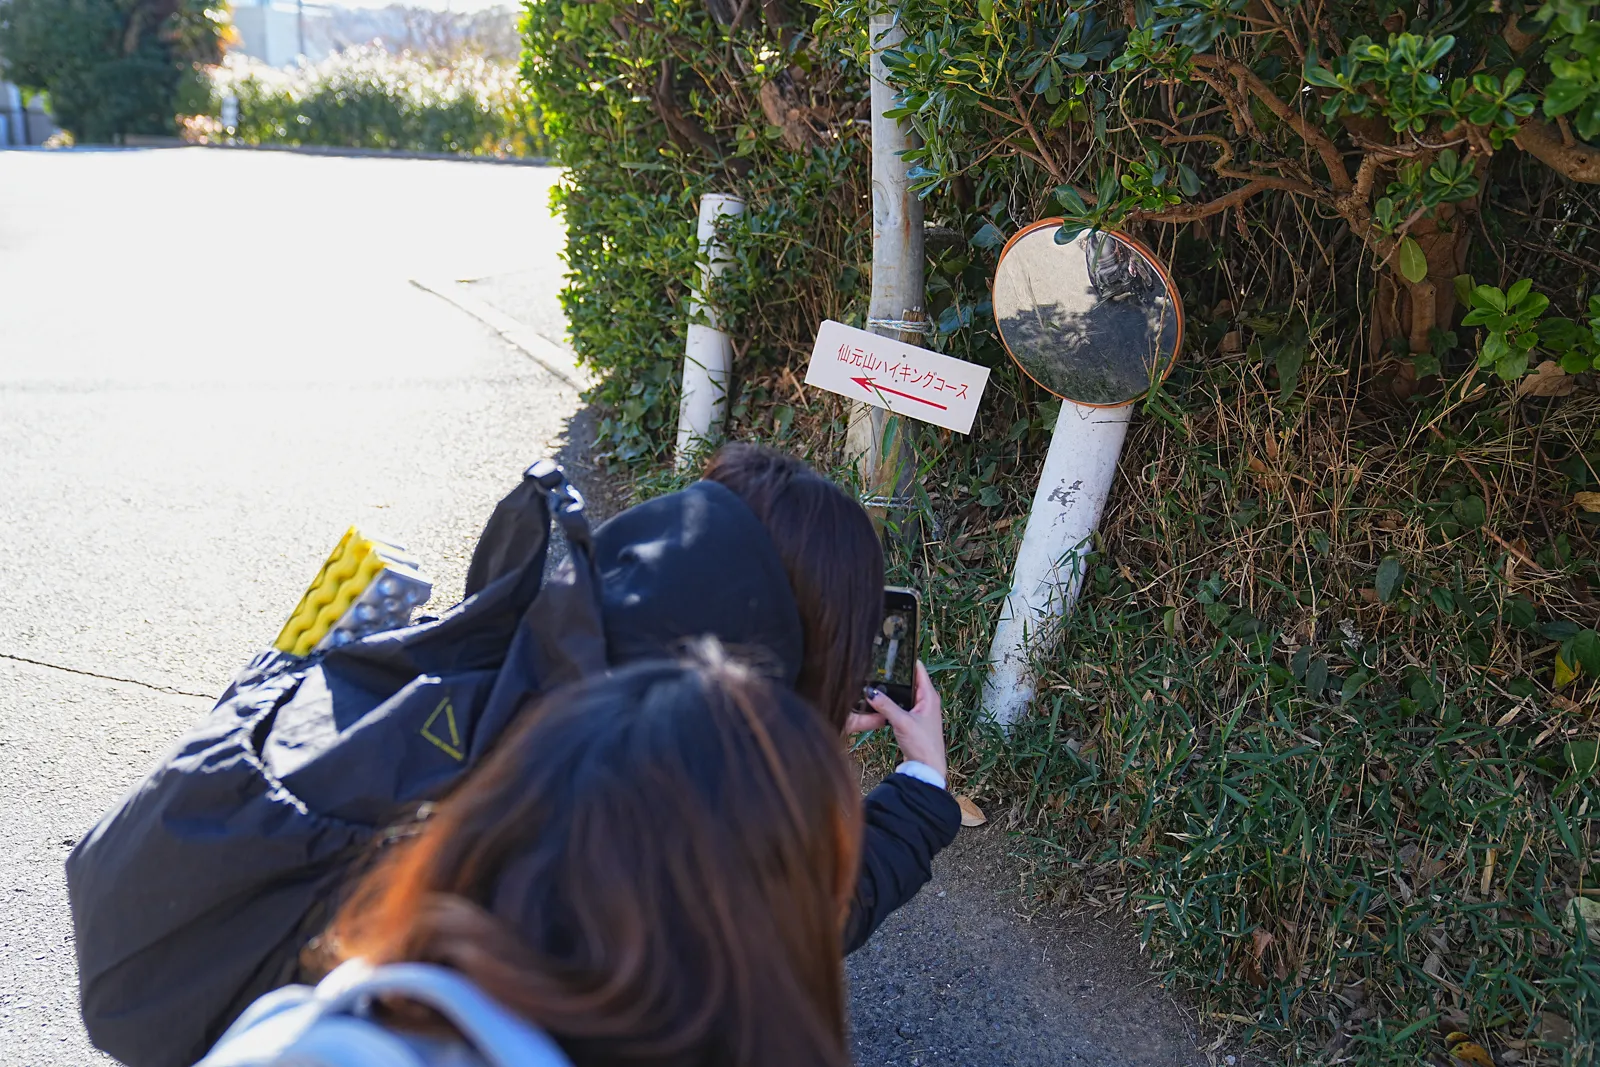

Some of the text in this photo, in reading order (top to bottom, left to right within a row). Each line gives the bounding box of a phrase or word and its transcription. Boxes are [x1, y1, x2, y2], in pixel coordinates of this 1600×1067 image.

[837, 343, 969, 400] 仙元山ハイキングコース
